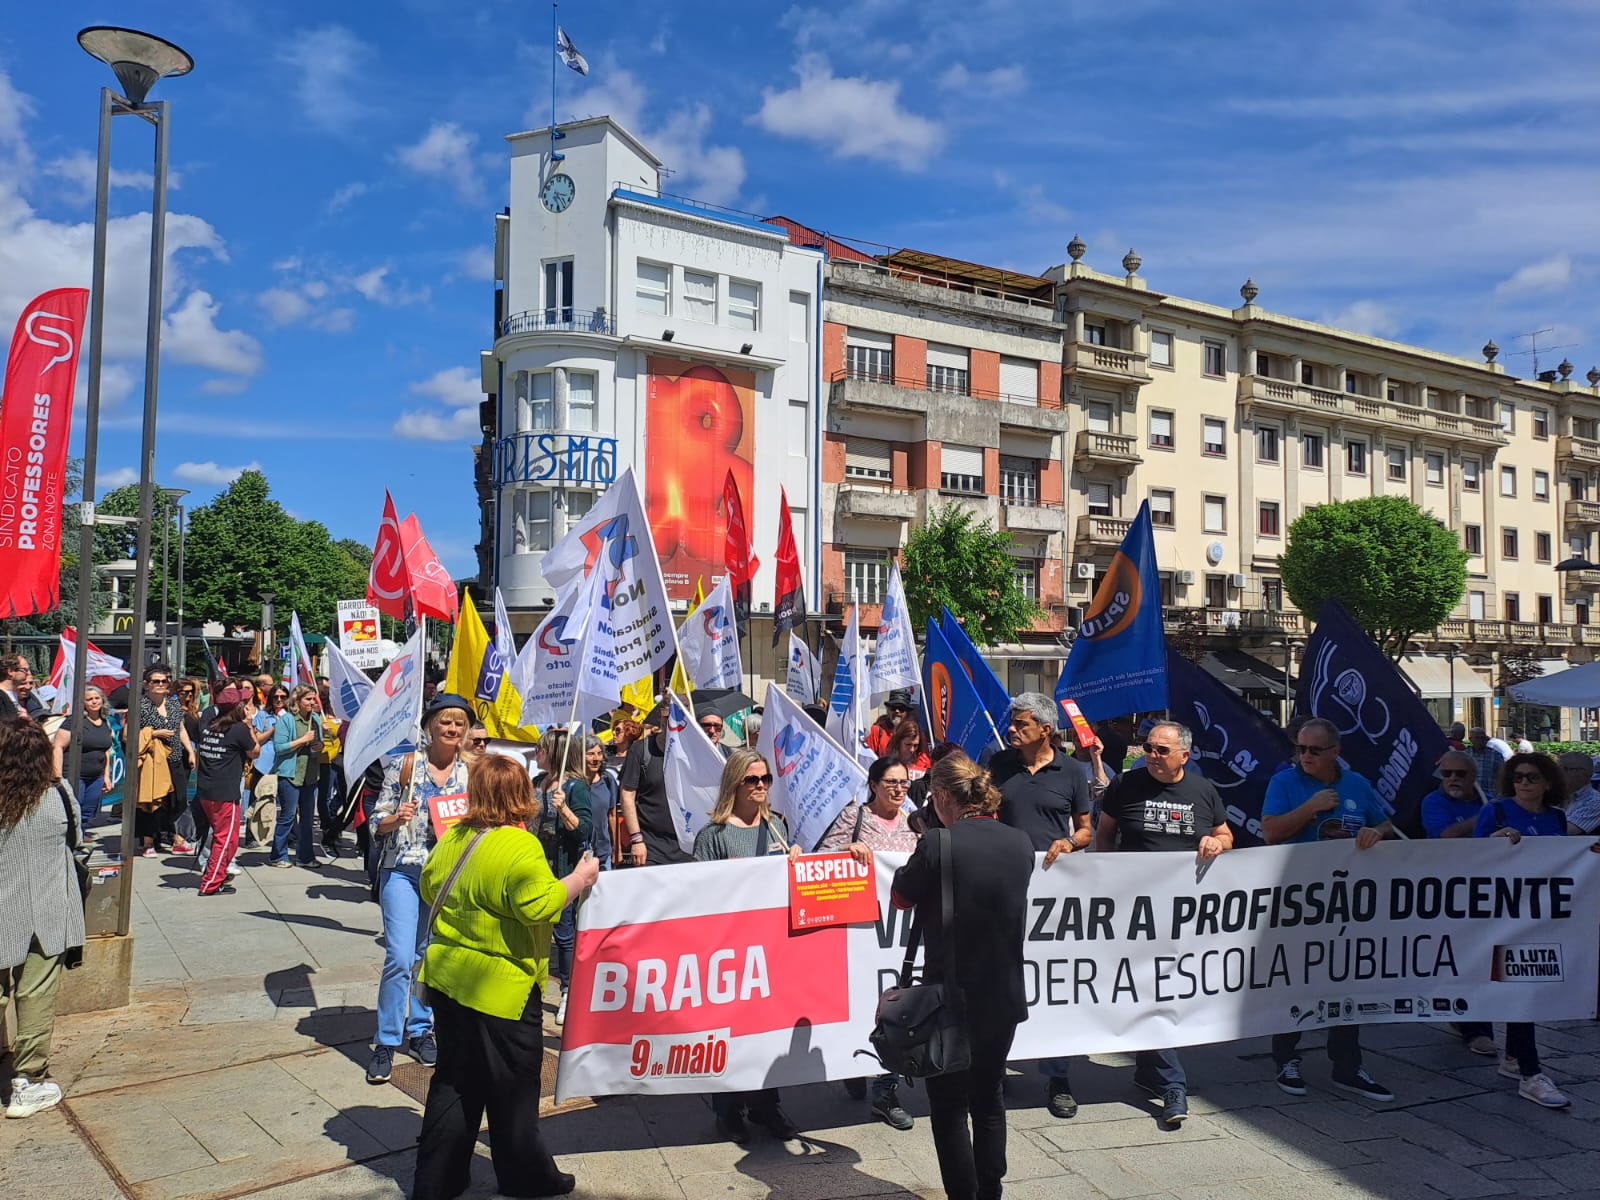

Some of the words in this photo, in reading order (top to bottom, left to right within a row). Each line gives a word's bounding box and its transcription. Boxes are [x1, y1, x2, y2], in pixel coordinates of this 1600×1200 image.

[18, 393, 50, 550] PROFESSORES
[492, 434, 617, 483] RISMO
[0, 447, 22, 547] SINDICATO
[45, 472, 58, 514] NORTE
[42, 519, 55, 550] ZONA
[436, 798, 468, 819] RES
[794, 857, 869, 883] RESPEITO
[1127, 896, 1156, 940] A
[1171, 870, 1376, 940] PROFISSÃO
[1390, 877, 1575, 921] DOCENTE
[1111, 957, 1139, 1004] A
[1154, 943, 1291, 1003] ESCOLA
[1304, 925, 1459, 985] PÚBLICA
[1504, 949, 1516, 962] A
[1519, 949, 1558, 962] LUTA
[1505, 963, 1561, 977] CONTINUA
[589, 945, 772, 1014] BRAGA
[630, 1038, 652, 1077] 9
[651, 1061, 664, 1076] de
[666, 1034, 729, 1076] maio
